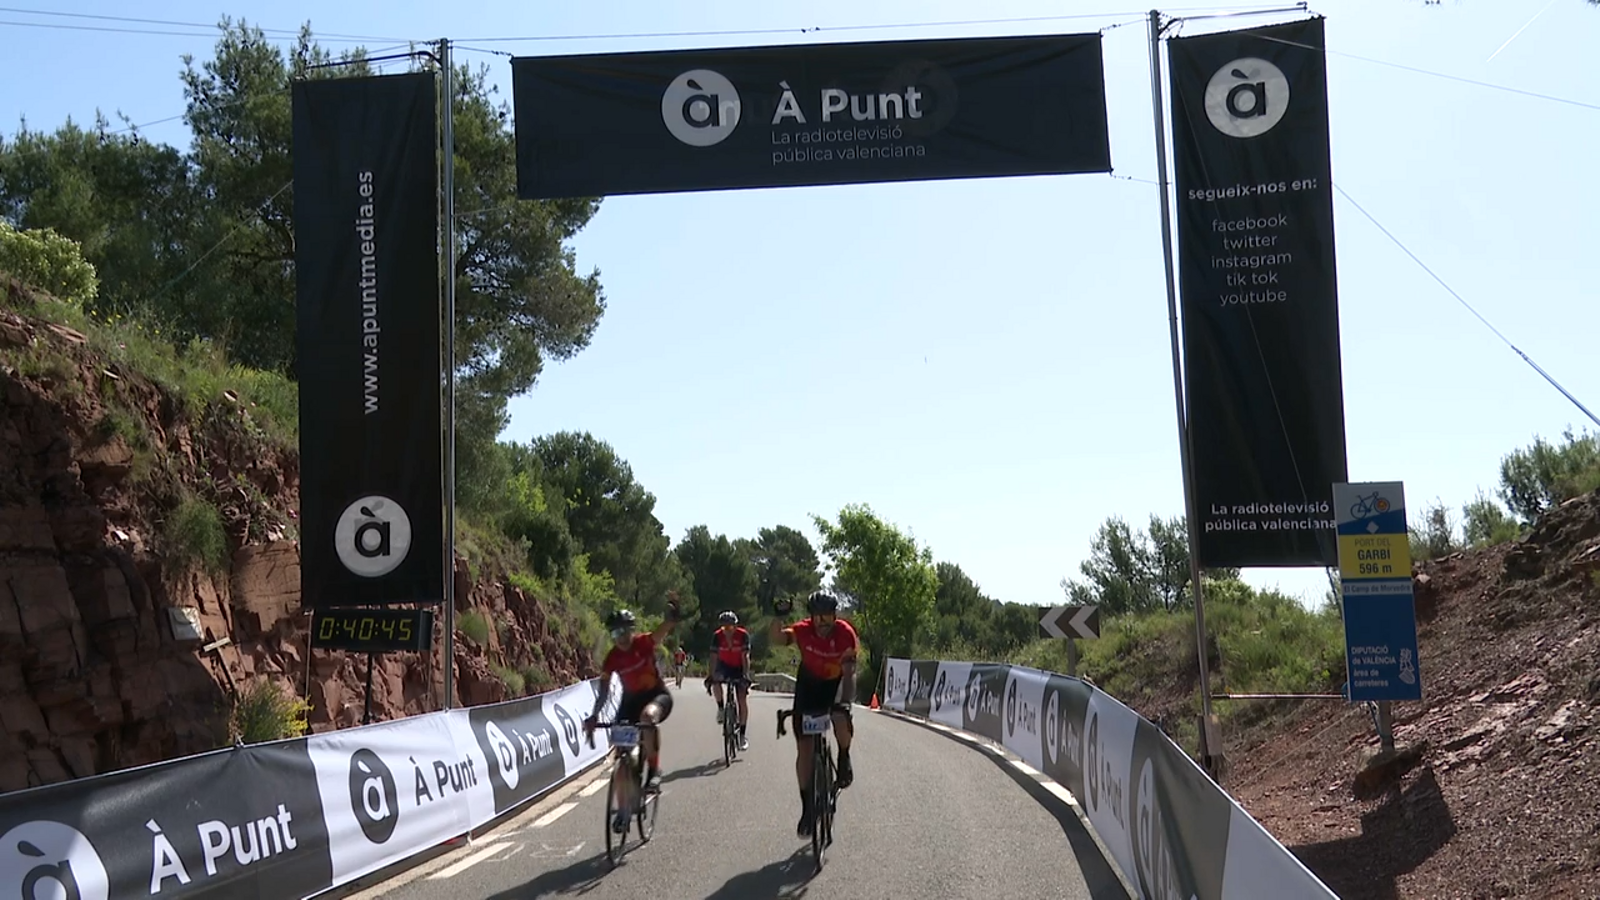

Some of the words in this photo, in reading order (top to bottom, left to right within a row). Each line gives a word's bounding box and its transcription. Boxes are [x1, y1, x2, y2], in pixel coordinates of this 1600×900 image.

[772, 81, 806, 124] À
[821, 86, 922, 122] Punt
[772, 131, 791, 144] La
[795, 125, 903, 143] radiotelevisió
[772, 147, 833, 165] pública
[837, 144, 926, 160] valenciana
[1188, 183, 1287, 201] segueix-nos
[1291, 178, 1318, 191] en:
[1212, 213, 1288, 232] facebook
[1223, 234, 1278, 250] twitter
[1211, 252, 1292, 269] instagram
[1226, 273, 1246, 287] tik
[1251, 270, 1279, 284] tok
[356, 171, 378, 414] www.apuntmedia.es
[1219, 289, 1287, 307] youtube
[1211, 504, 1228, 515] La
[1232, 501, 1330, 515] radiotelevisió
[1205, 519, 1257, 532] pública
[1261, 518, 1336, 530] valenciana
[1360, 563, 1380, 574] 596
[1382, 565, 1392, 573] m
[319, 617, 412, 641] 0:40:45
[512, 729, 531, 765] À
[526, 728, 553, 761] Punt
[409, 756, 434, 806] À
[432, 753, 477, 798] Punt
[146, 819, 191, 894] À
[197, 804, 297, 876] Punt
